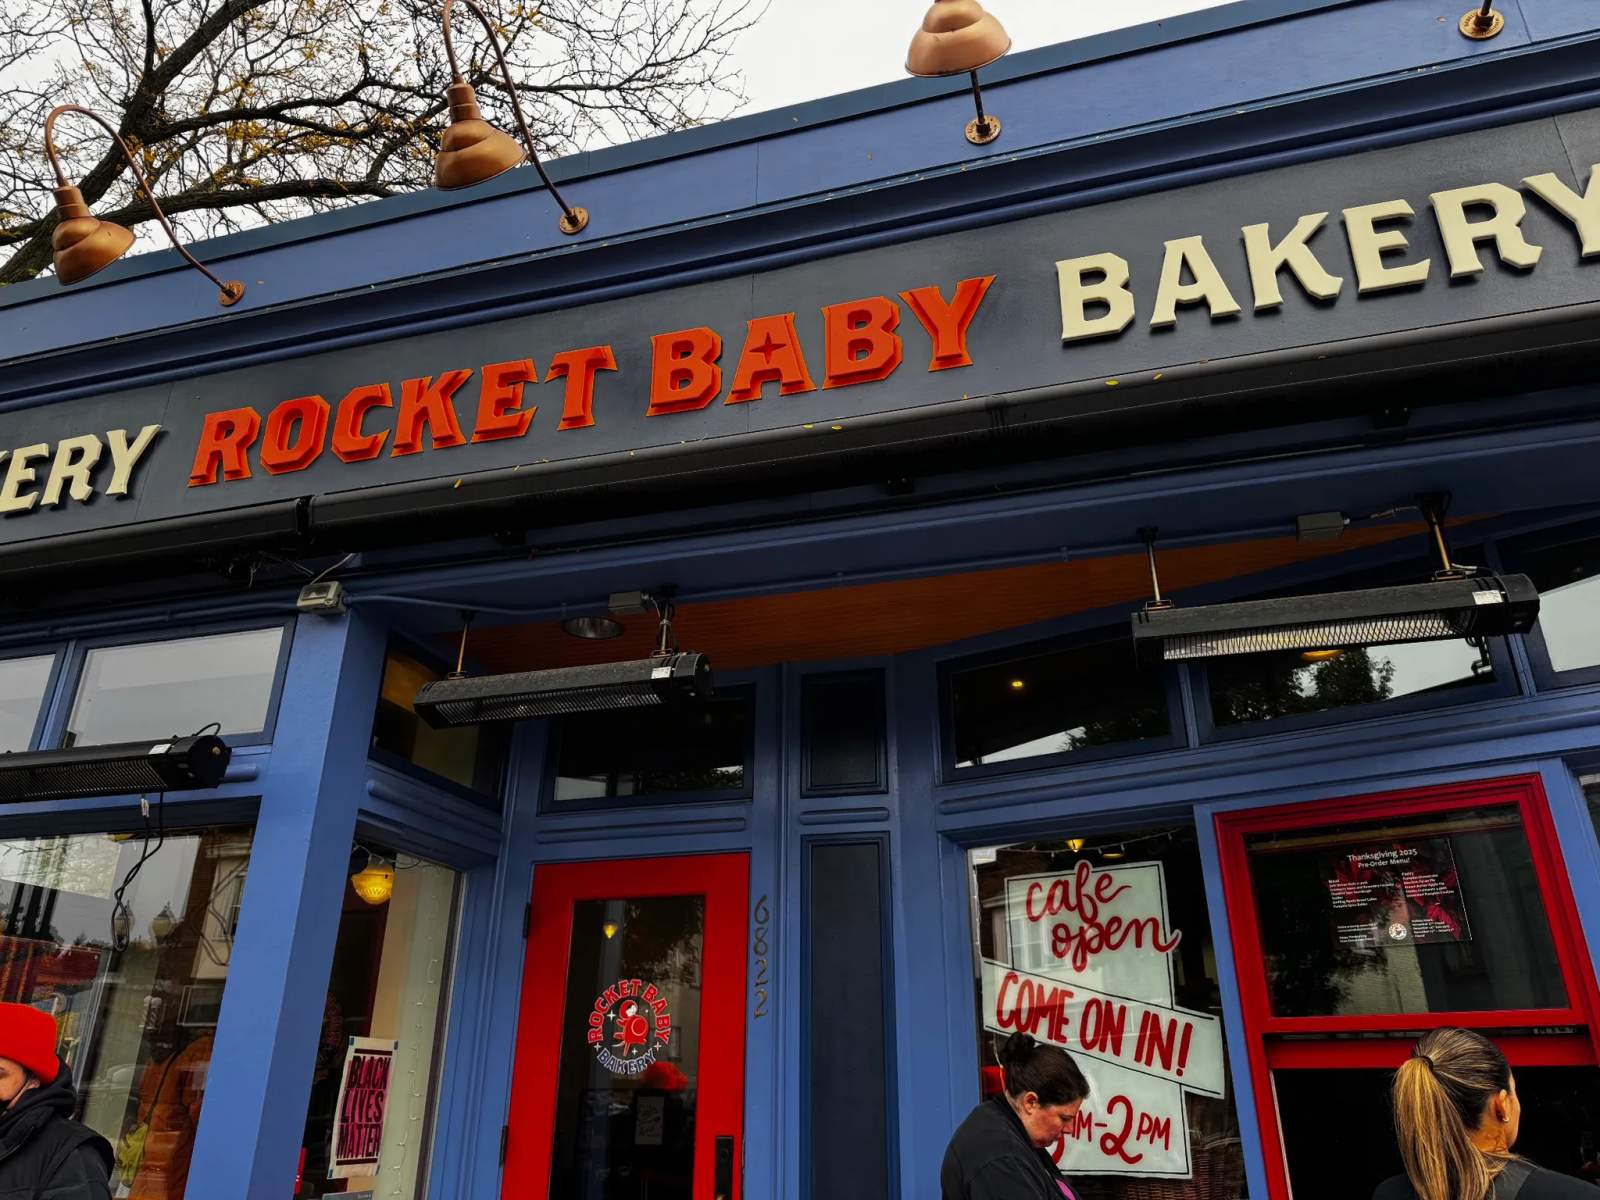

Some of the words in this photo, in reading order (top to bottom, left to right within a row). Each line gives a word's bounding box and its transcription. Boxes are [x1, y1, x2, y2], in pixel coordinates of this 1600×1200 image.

[1055, 162, 1600, 342] BAKERY
[187, 343, 618, 487] ROCKET
[645, 274, 997, 417] BABY
[0, 424, 163, 513] ERY
[1346, 850, 1398, 862] Thanksgiving
[1399, 848, 1418, 857] 2025
[1358, 860, 1389, 869] Pre-Order
[1025, 861, 1132, 923] cafe
[753, 895, 770, 1019] 6822
[1051, 916, 1182, 973] open
[587, 978, 642, 1044] ROCKET
[641, 983, 671, 1045] BABY
[996, 971, 1075, 1045] COME
[1079, 998, 1127, 1058] ON
[1134, 1010, 1194, 1077] IN!
[346, 1055, 392, 1090] BLACK
[597, 1047, 657, 1075] BAKERY
[340, 1088, 386, 1124] LIVES
[335, 1122, 384, 1160] MATTER
